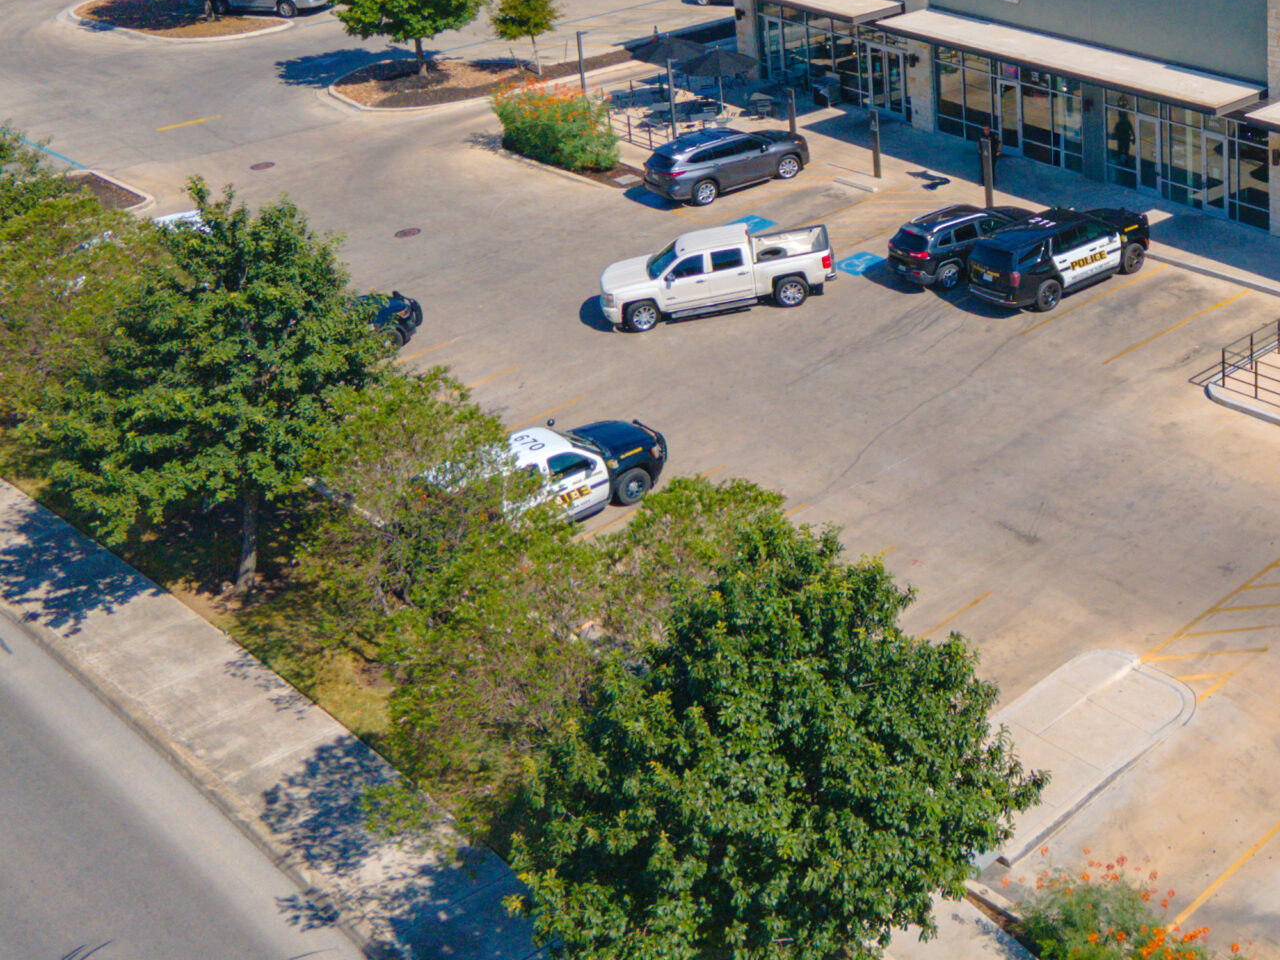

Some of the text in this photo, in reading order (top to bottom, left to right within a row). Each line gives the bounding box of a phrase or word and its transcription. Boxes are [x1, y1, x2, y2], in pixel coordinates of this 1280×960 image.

[1028, 217, 1057, 227] 211
[1070, 250, 1107, 271] POLICE
[514, 434, 546, 451] 670
